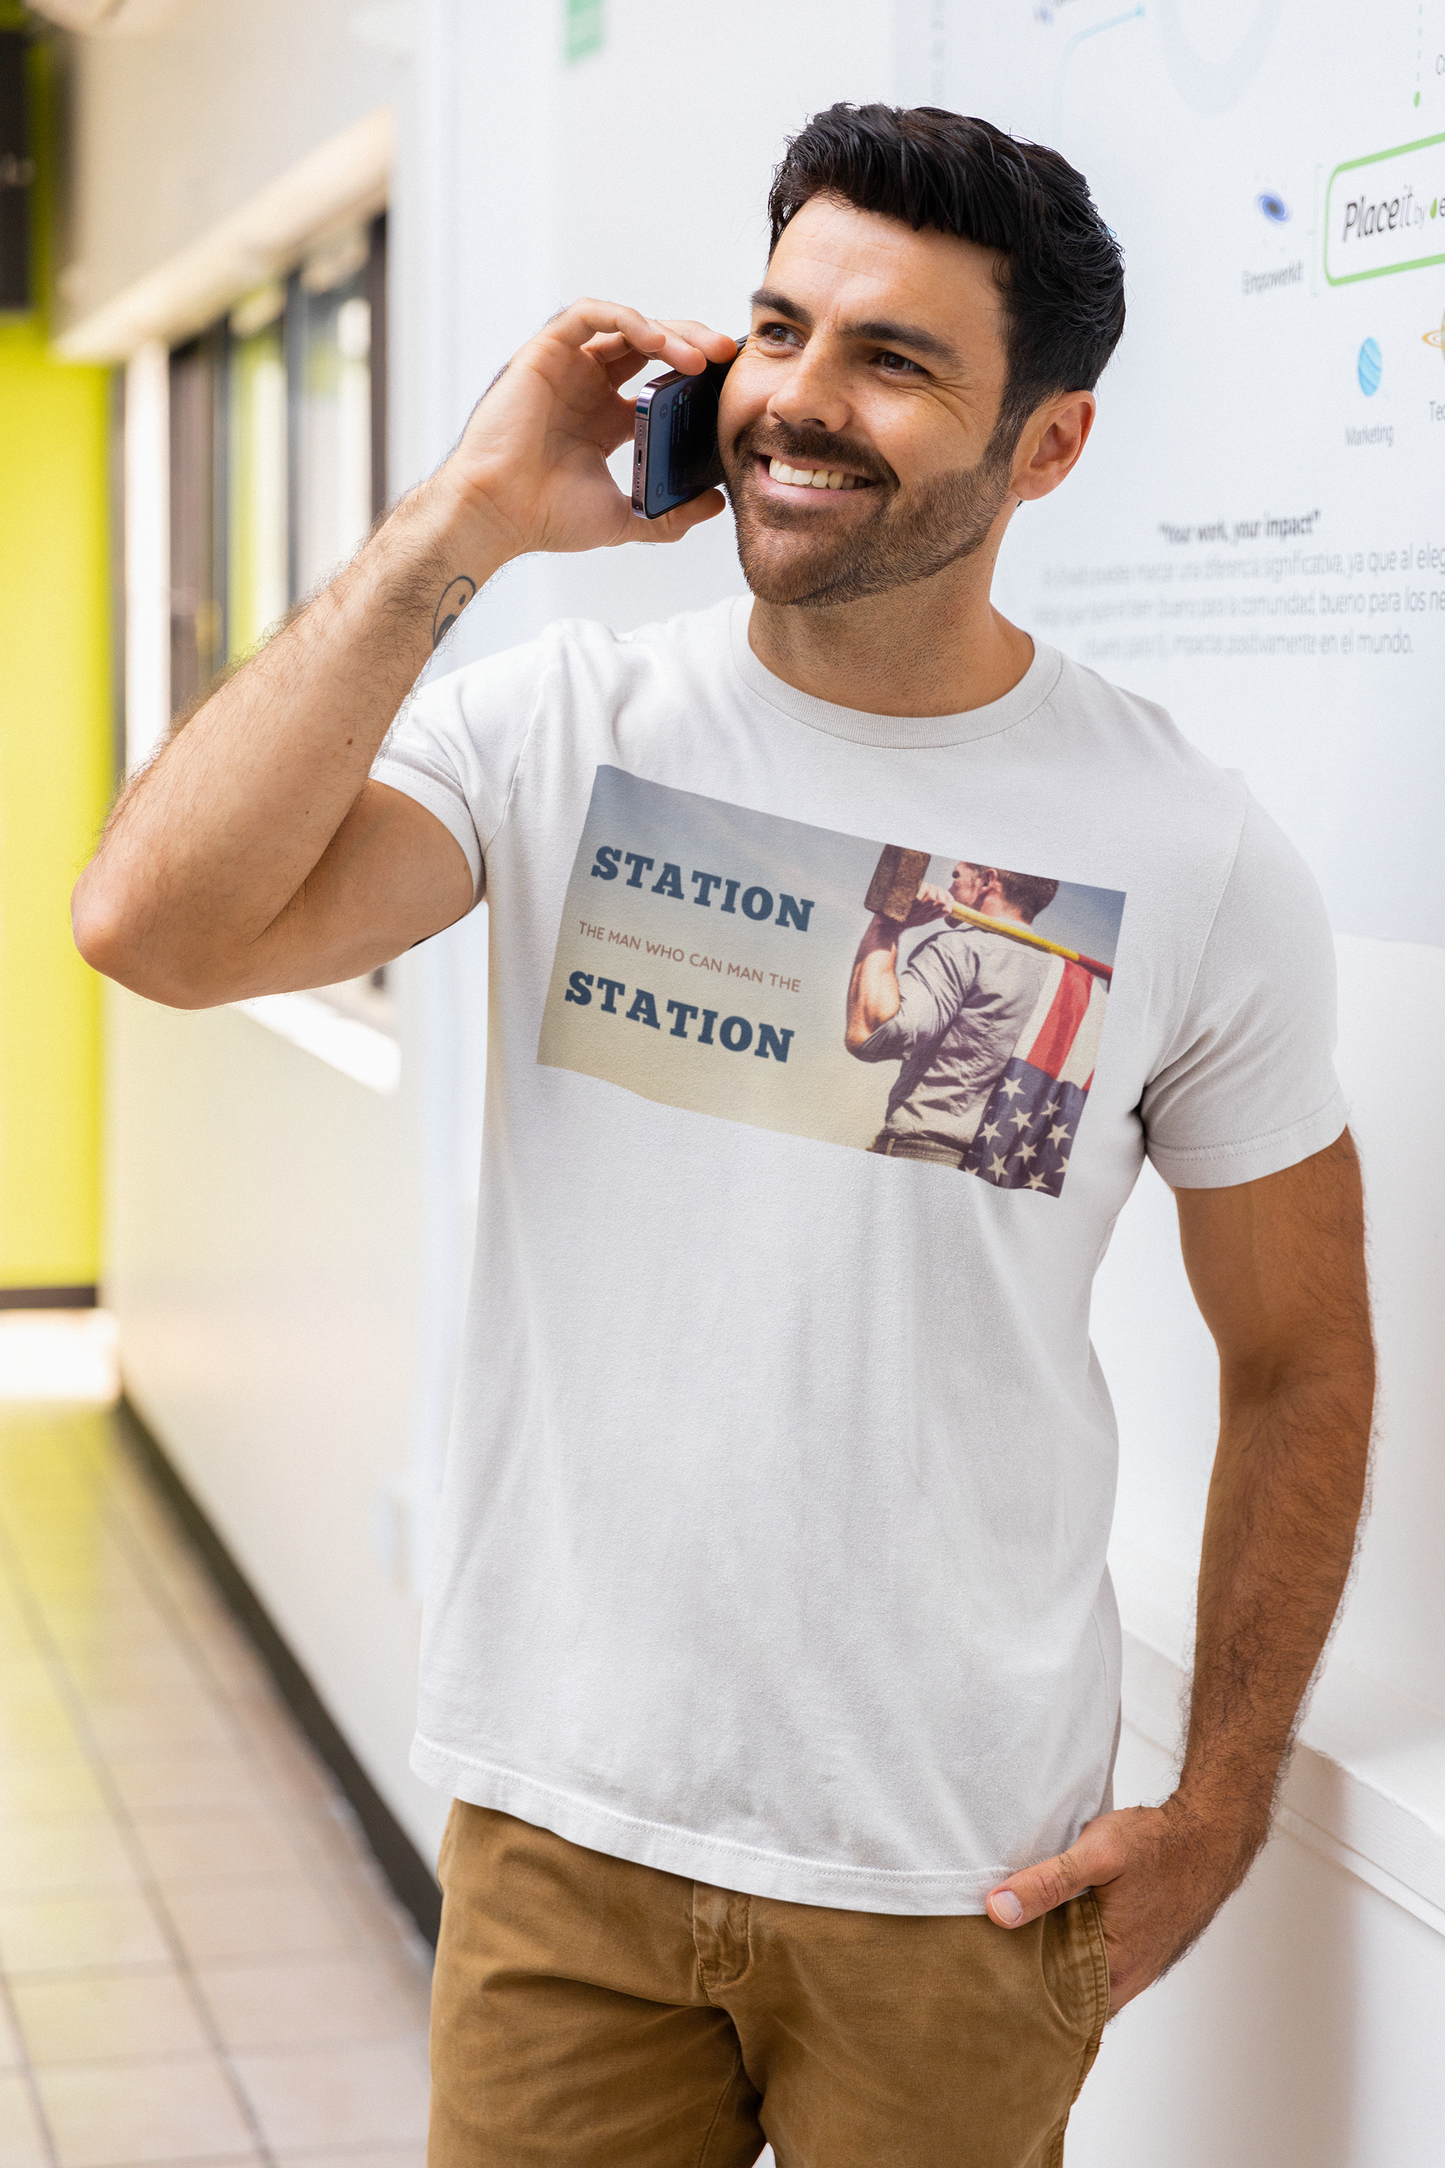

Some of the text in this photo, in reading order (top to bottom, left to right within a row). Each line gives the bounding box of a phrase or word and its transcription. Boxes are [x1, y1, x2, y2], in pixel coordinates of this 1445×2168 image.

[1343, 184, 1413, 242] Placeit
[1345, 423, 1394, 448] Marketing
[1232, 521, 1261, 547] your
[1347, 552, 1365, 580] ya
[1368, 550, 1398, 578] que
[1400, 542, 1414, 571] al
[1320, 589, 1366, 615] bueno
[1369, 591, 1402, 620] para
[1405, 585, 1427, 613] los
[1319, 633, 1338, 655] en
[1341, 627, 1355, 655] el
[1357, 627, 1414, 654] mundo.
[591, 846, 815, 932] STATION
[578, 921, 801, 993] THE MAN WHO CAN MAN THE
[564, 971, 795, 1063] STATION
